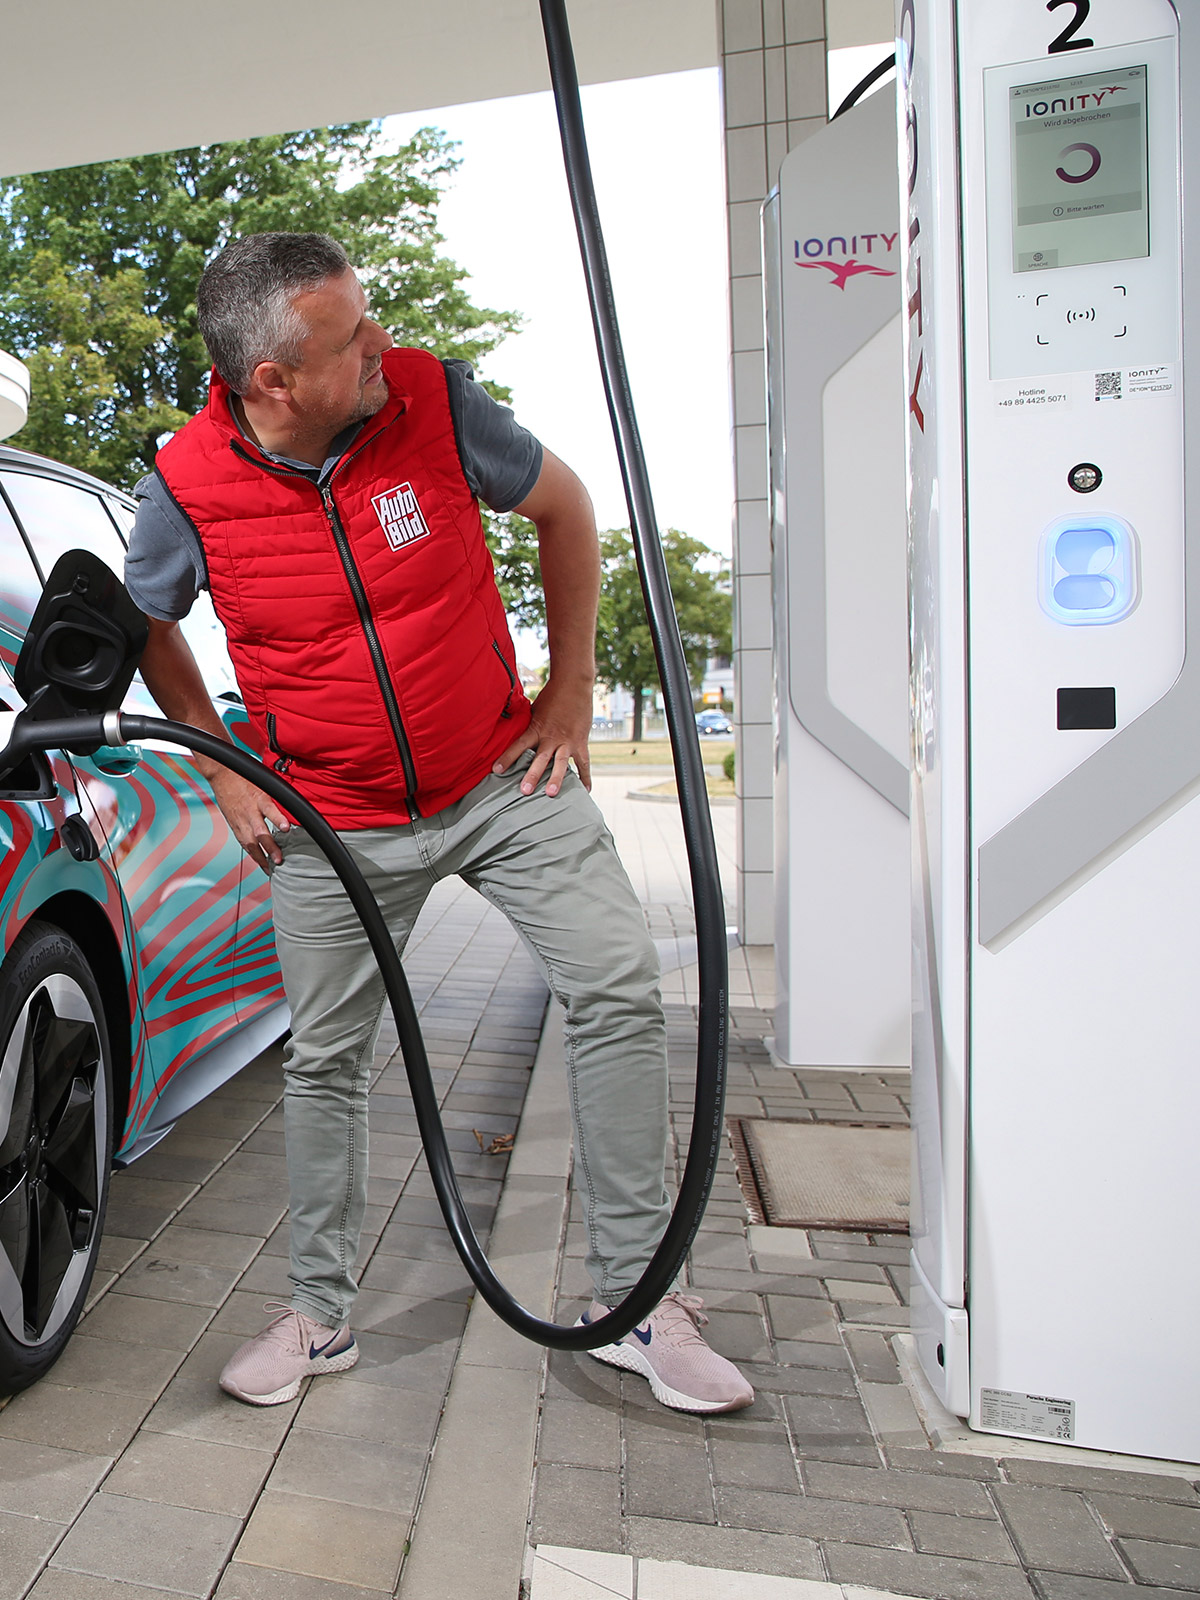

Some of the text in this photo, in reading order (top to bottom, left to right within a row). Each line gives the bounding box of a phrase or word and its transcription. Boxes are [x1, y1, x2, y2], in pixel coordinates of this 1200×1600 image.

[1046, 0, 1094, 54] 2
[1026, 91, 1106, 118] IONITY
[1043, 112, 1111, 128] Wird abgebrochen
[1067, 203, 1105, 214] Bitte warten
[794, 232, 898, 259] IONITY
[1129, 369, 1160, 378] IONITY
[999, 394, 1067, 407] +49 89 4425 5071
[1018, 388, 1046, 397] Hotline
[379, 489, 416, 526] Auto
[387, 511, 425, 547] Bild
[715, 1096, 721, 1105] IN
